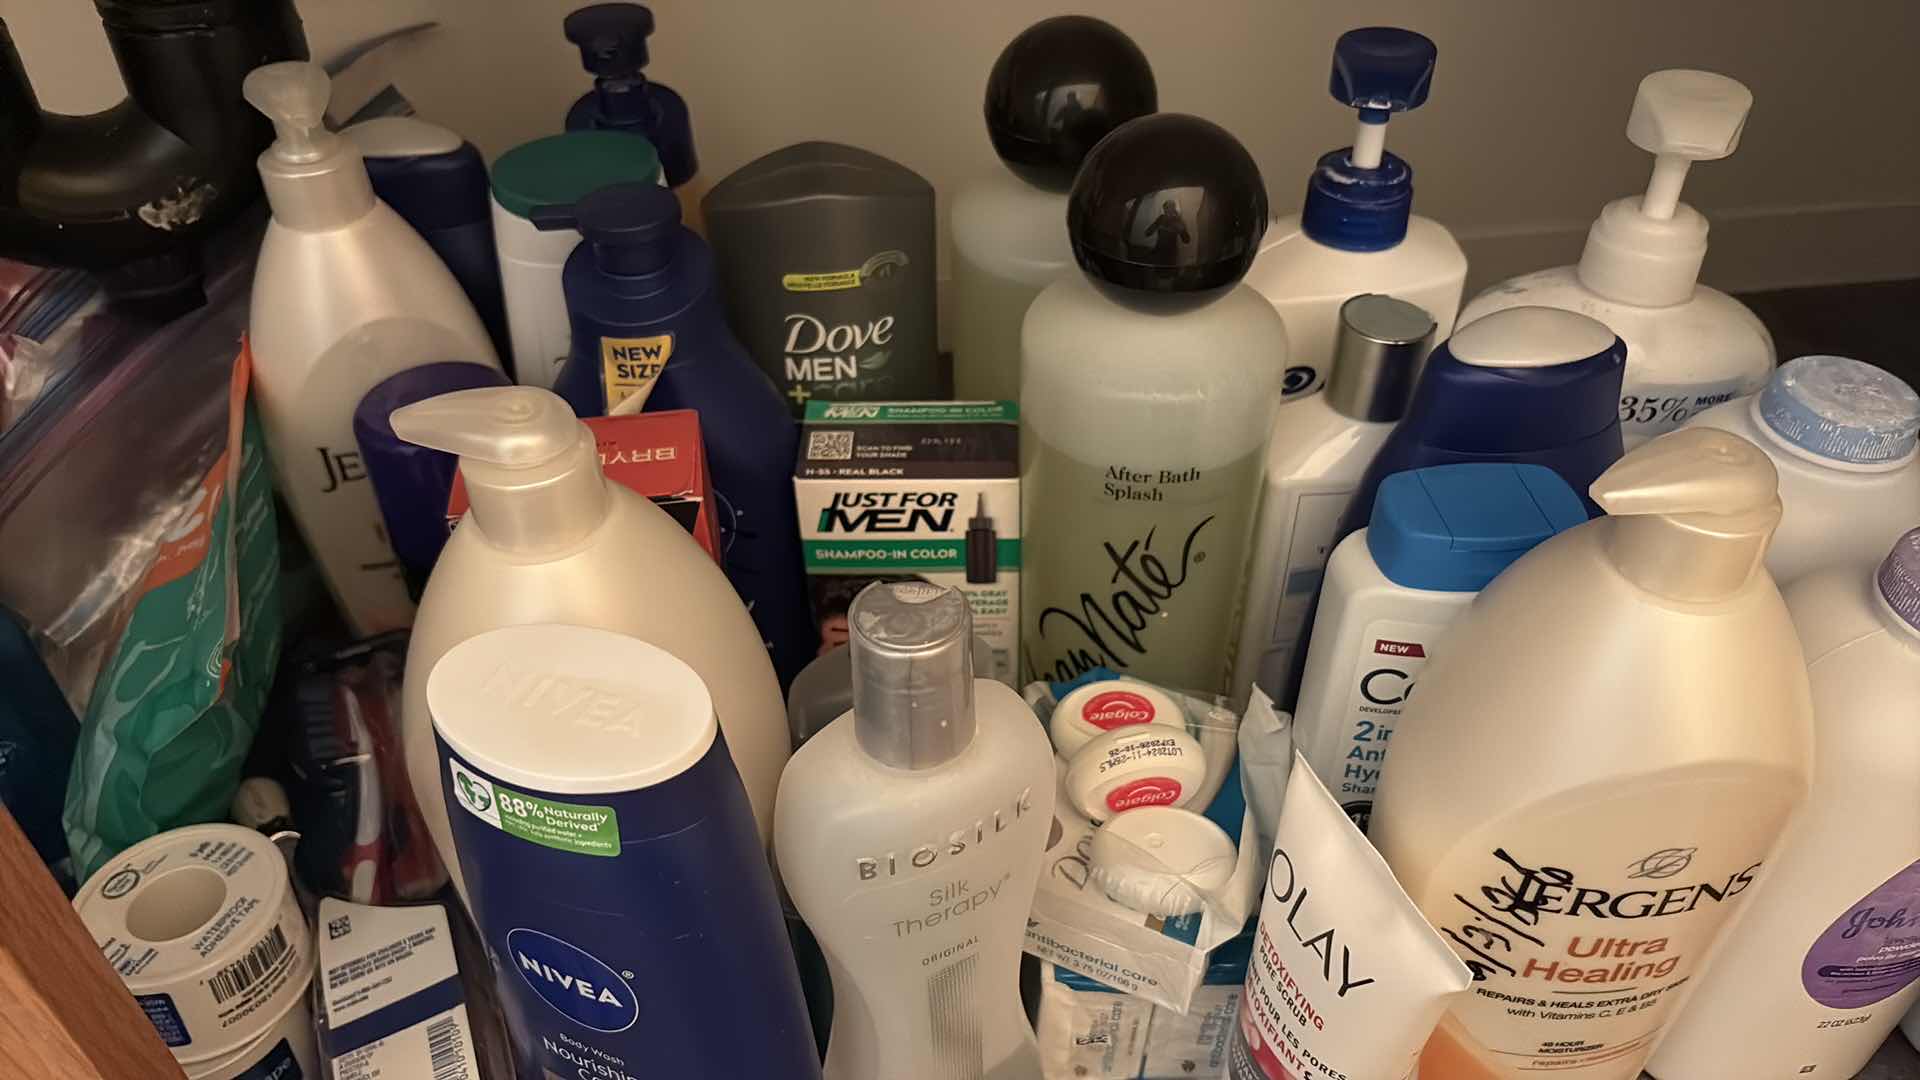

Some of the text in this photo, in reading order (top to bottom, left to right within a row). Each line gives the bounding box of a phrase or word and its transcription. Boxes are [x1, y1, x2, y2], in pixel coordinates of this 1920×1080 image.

[784, 314, 895, 354] Dove
[612, 345, 663, 361] NEW
[785, 355, 857, 381] MEN
[1620, 395, 1689, 423] 35%
[599, 447, 677, 464] BRYL
[316, 447, 368, 493] JE
[838, 468, 866, 476] REAL
[868, 468, 904, 476] BLACK
[1104, 465, 1201, 485] After Bath
[830, 492, 958, 508] JUST FOR
[1103, 483, 1164, 502] Splash
[817, 508, 955, 532] MEN
[815, 548, 958, 560] SHAMPOO-IN COLOR
[1379, 643, 1409, 654] NEW
[1089, 708, 1150, 722] Colgate
[1353, 720, 1375, 742] 2
[499, 793, 608, 825] 88% Naturally
[1115, 789, 1177, 808] Colgate
[856, 785, 1032, 881] BIOSILK
[929, 879, 969, 907] Silk
[1510, 861, 1763, 920] JERGENS
[892, 879, 1003, 938] Therapy
[1270, 848, 1376, 998] OLAY
[921, 935, 980, 967] ORIGINAL
[1566, 935, 1670, 959] Ultra
[518, 949, 625, 1009] NIVEA
[1121, 968, 1159, 987] care
[1259, 921, 1326, 1032] DETOXIFYING
[1522, 954, 1682, 984] Healing
[1258, 944, 1308, 1028] PORE SCRUB
[1475, 987, 1537, 1007] REPAIRS
[1549, 1000, 1594, 1009] HEALS
[1596, 995, 1638, 1008] EXTRA
[1640, 987, 1664, 1001] DRY
[1259, 984, 1281, 1023] POUR
[1281, 1023, 1300, 1050] LES
[1506, 1008, 1536, 1019] with
[1539, 1010, 1596, 1021] Vitamins
[1614, 1007, 1626, 1017] E
[559, 1032, 625, 1067] Body Wash
[1555, 1040, 1585, 1048] HOUR
